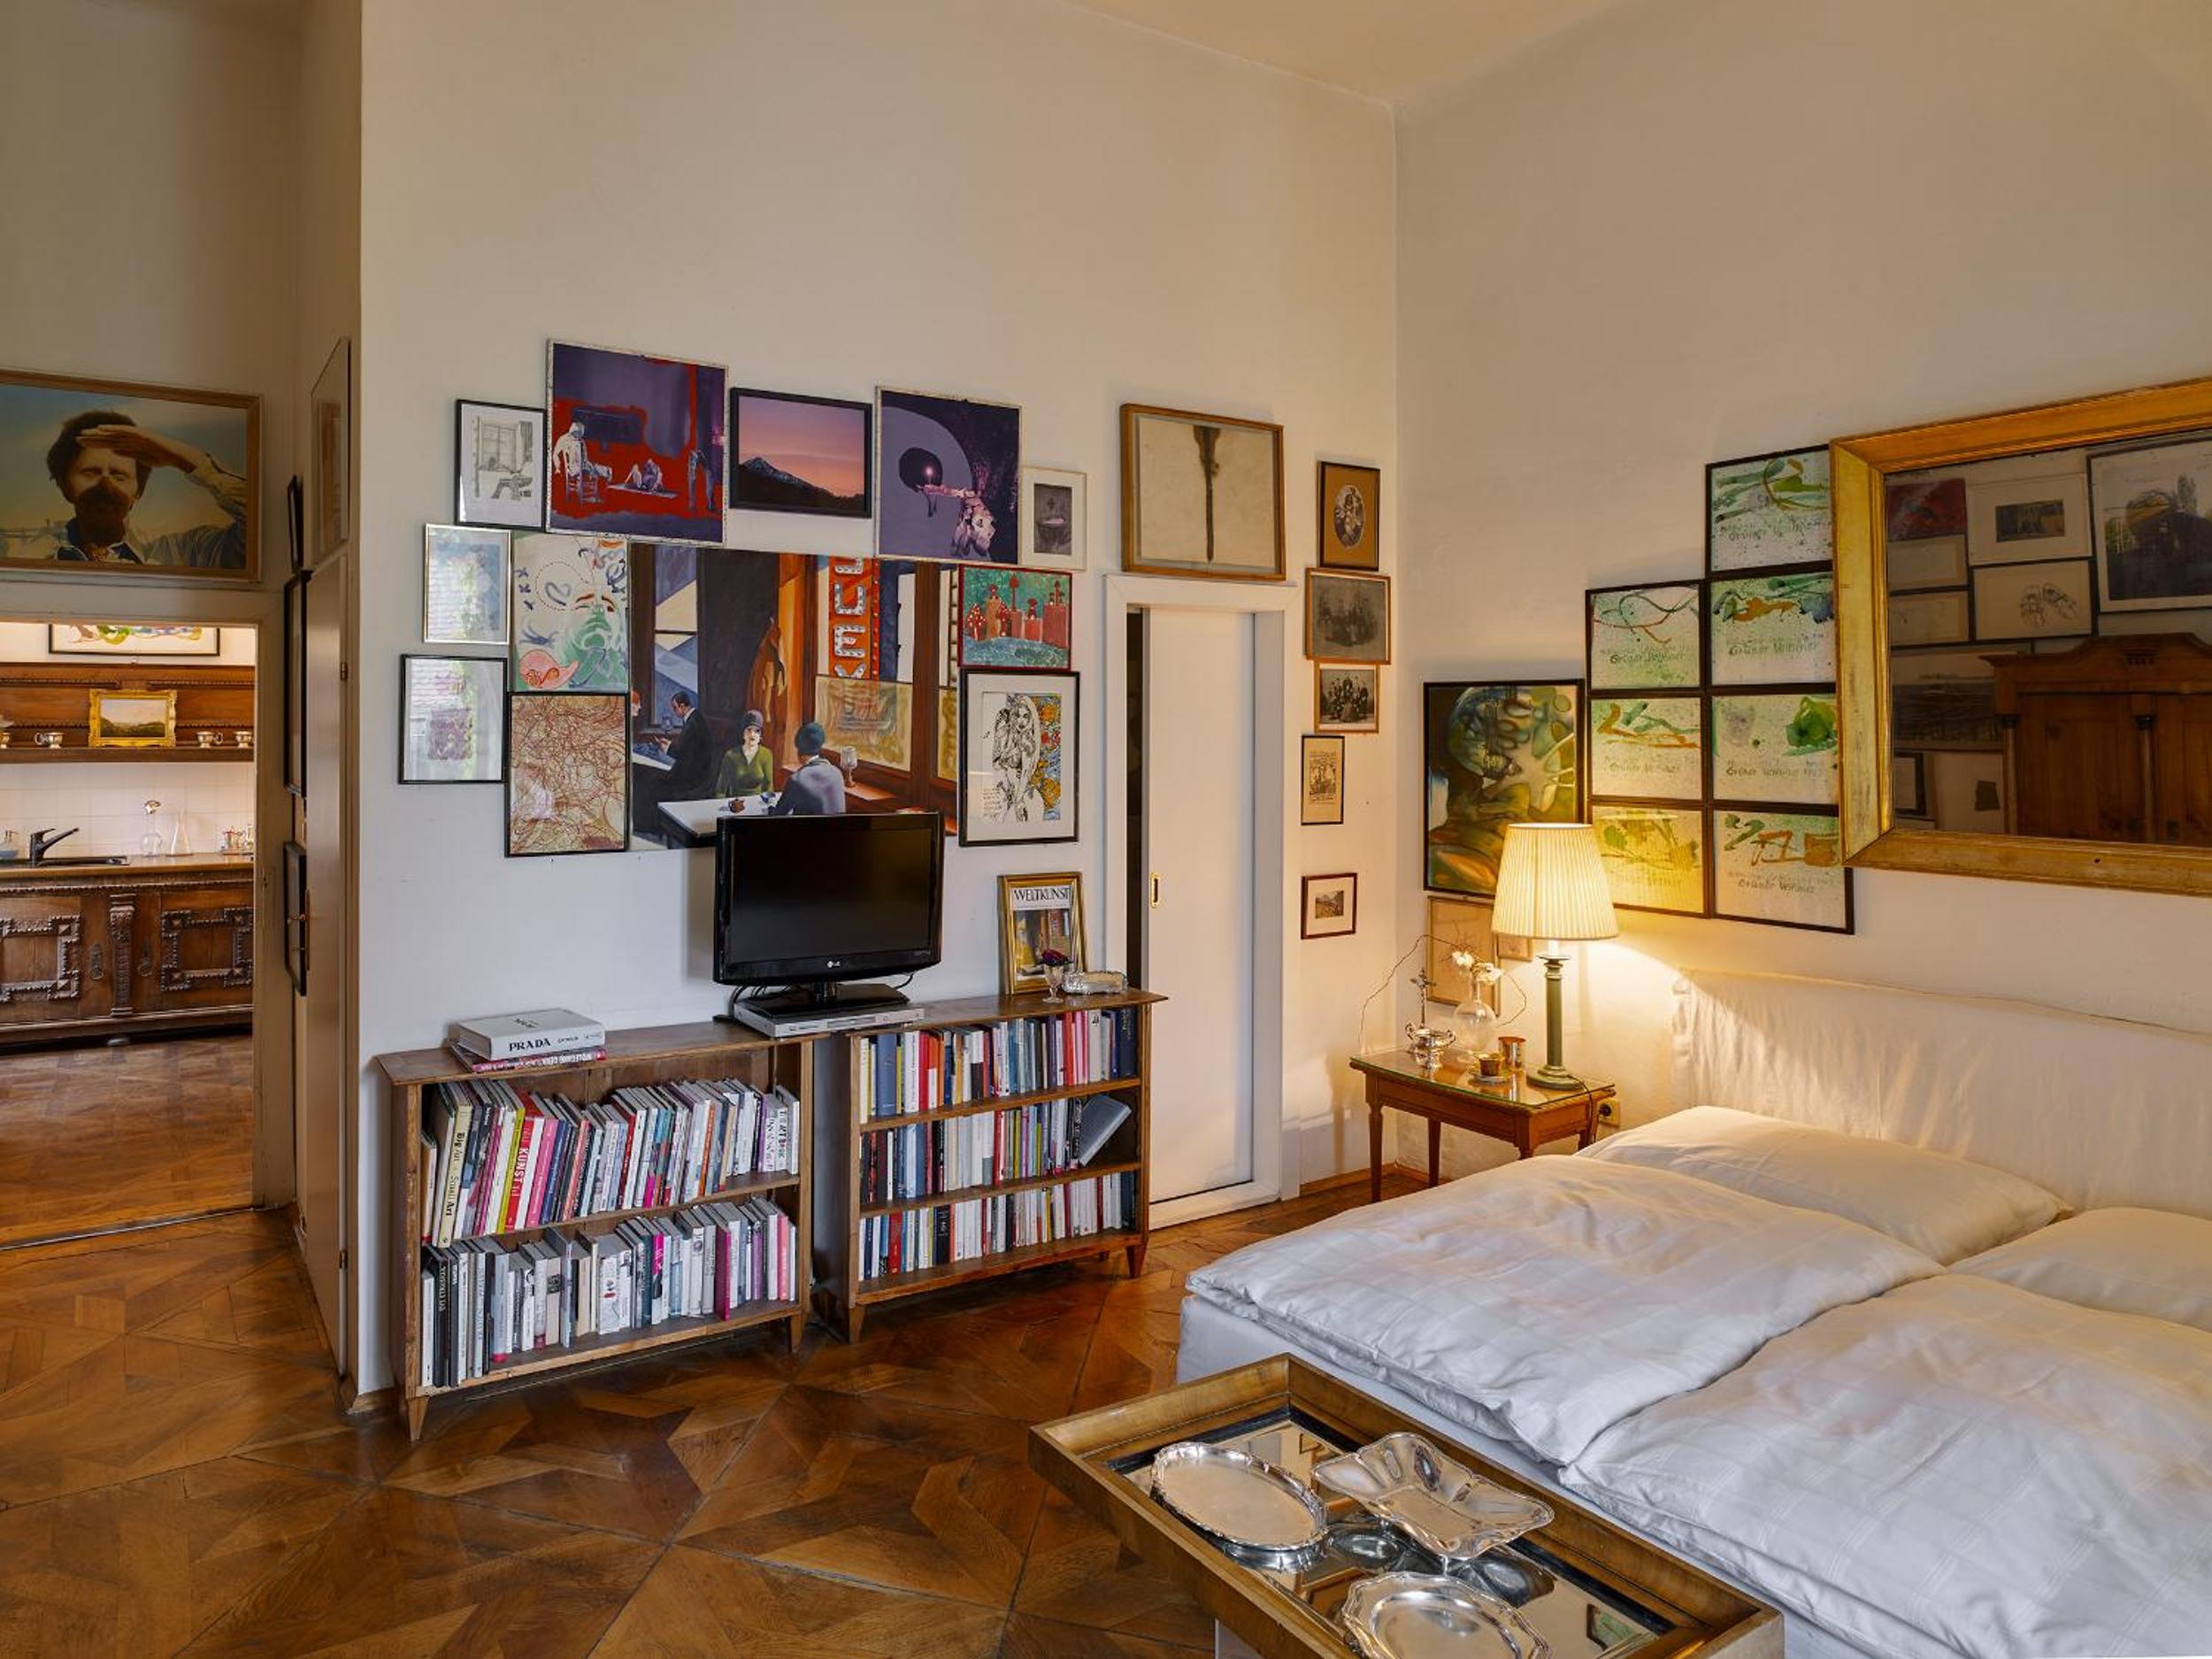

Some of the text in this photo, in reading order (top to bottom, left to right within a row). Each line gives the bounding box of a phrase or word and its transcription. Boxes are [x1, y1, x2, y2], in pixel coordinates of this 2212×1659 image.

[1014, 887, 1070, 902] WELTKUNST
[509, 1037, 551, 1052] PRADA
[445, 1202, 455, 1217] Art
